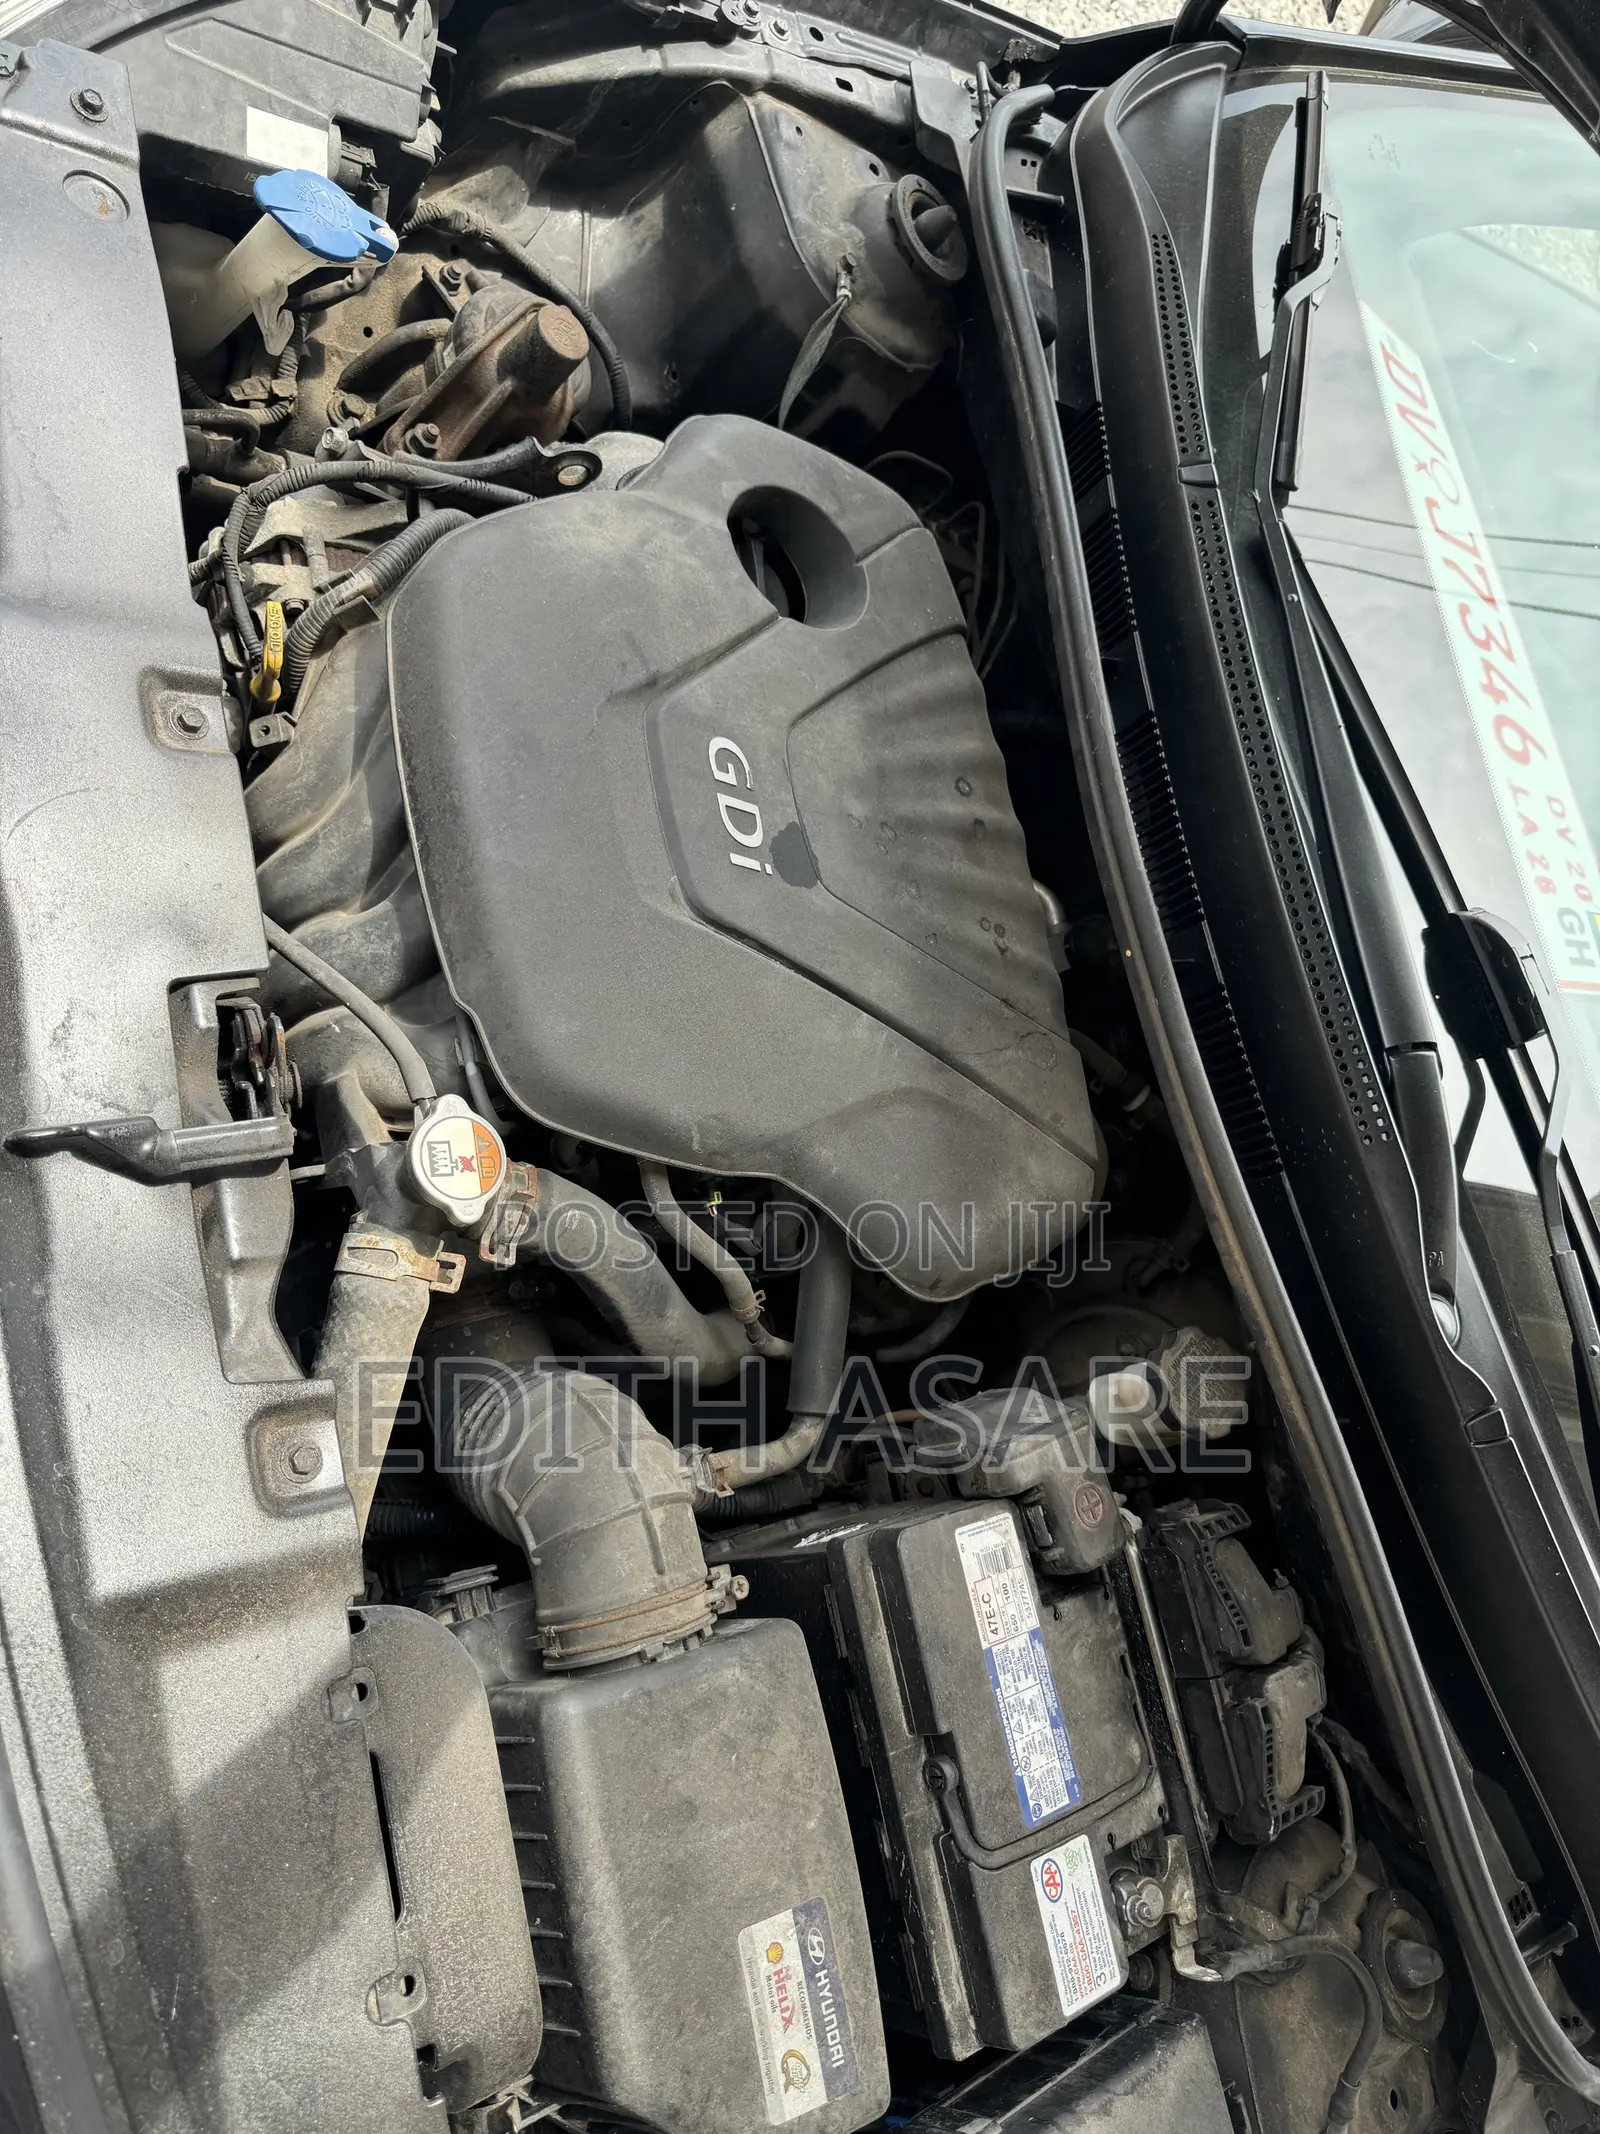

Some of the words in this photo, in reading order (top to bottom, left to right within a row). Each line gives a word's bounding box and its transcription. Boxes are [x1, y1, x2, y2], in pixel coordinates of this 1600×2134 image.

[269, 607, 279, 628] ENG
[270, 630, 279, 649] OIL
[709, 736, 772, 876] GDi
[1555, 906, 1597, 970] GH
[980, 1592, 999, 1635] 47E-C
[1001, 1582, 1010, 1601] 100
[1009, 1613, 1019, 1632] 650
[995, 1687, 1019, 1766] DANGER/POISON
[1045, 1862, 1058, 1898] CAA
[1075, 1886, 1090, 1935] Replacement
[1067, 1942, 1085, 1999] www.CAA.ca
[1070, 1909, 1094, 1992] 1-800-CAA-4357
[772, 1968, 793, 2033] HELIX
[1094, 1971, 1107, 1986] 3
[796, 1981, 812, 2040] RECOMMENDS
[815, 1968, 845, 2068] HYUNDAI
